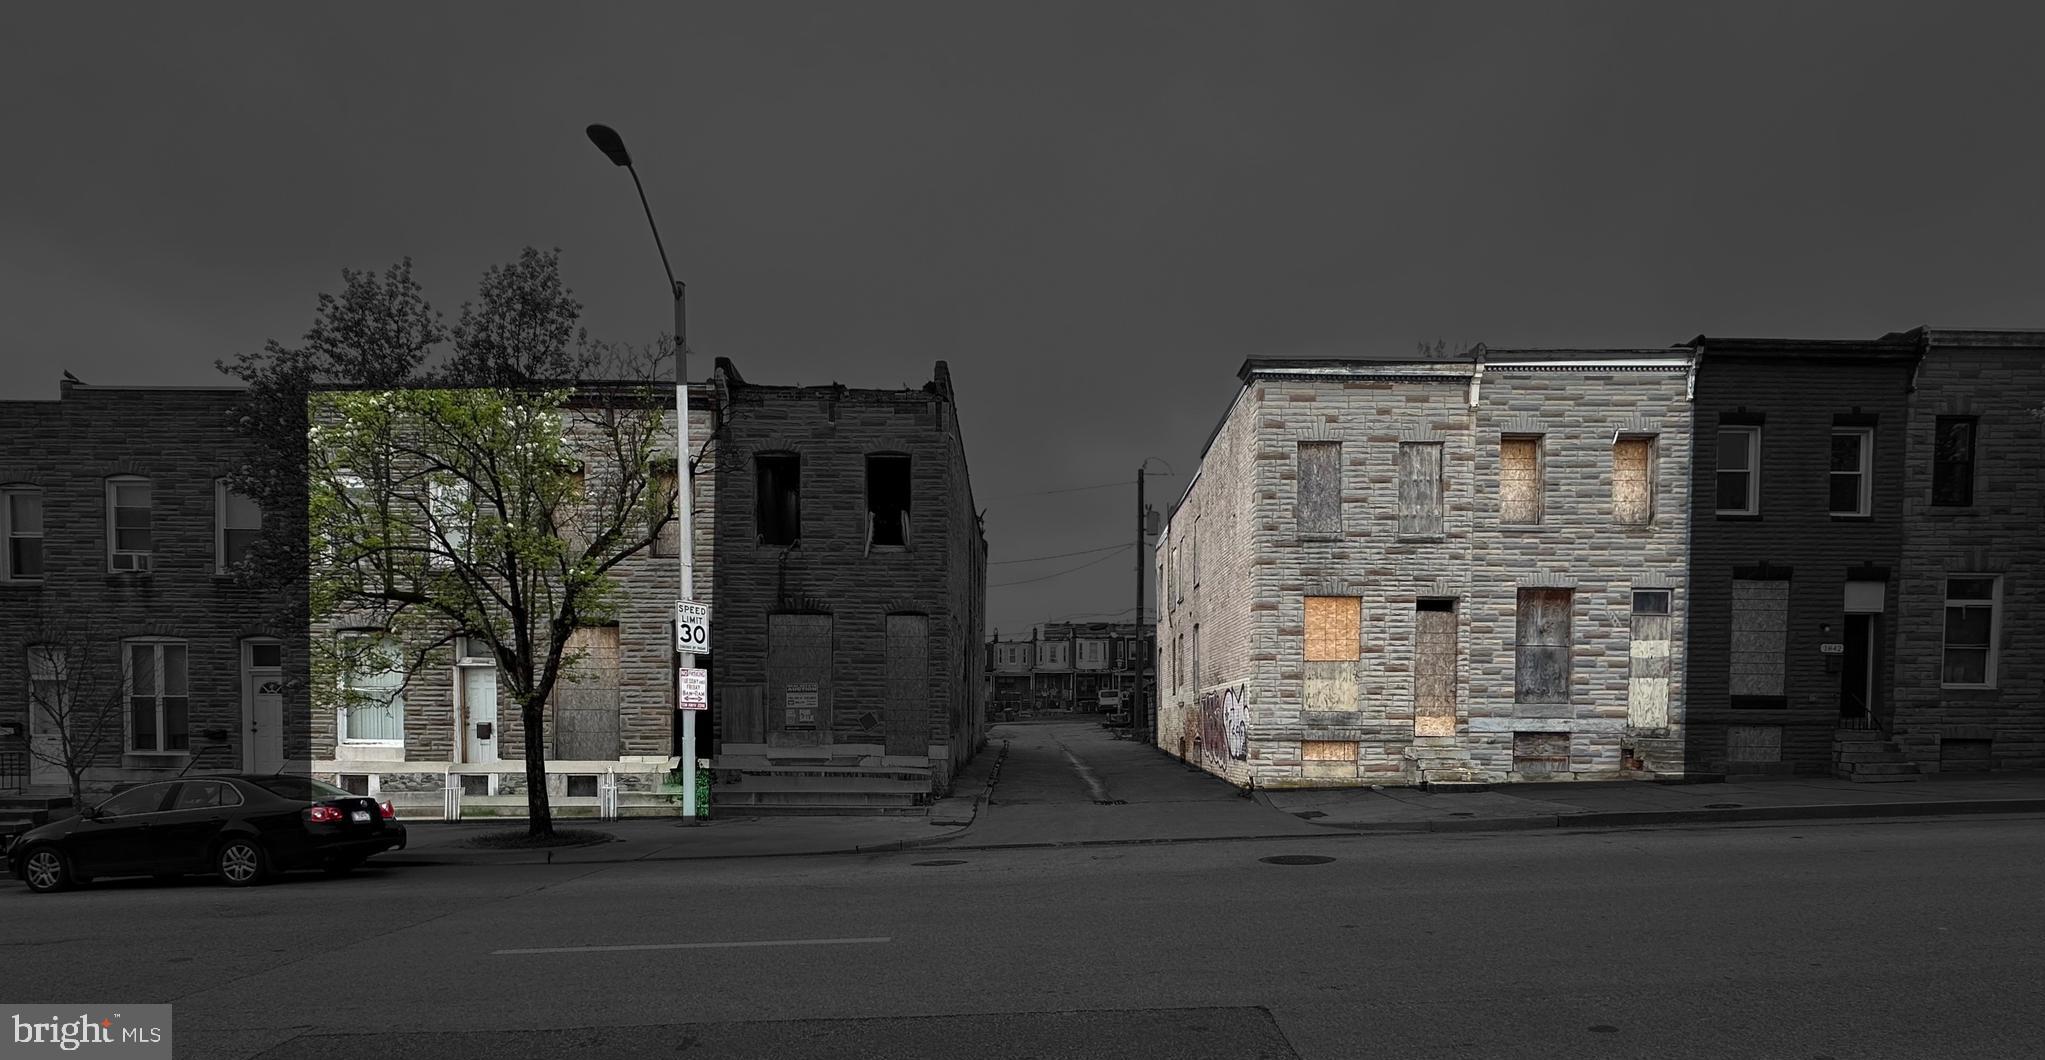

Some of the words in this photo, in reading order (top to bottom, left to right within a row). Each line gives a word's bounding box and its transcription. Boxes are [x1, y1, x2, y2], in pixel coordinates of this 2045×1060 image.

[678, 604, 706, 616] SPEED
[681, 615, 703, 625] LIMIT
[680, 624, 706, 644] 30
